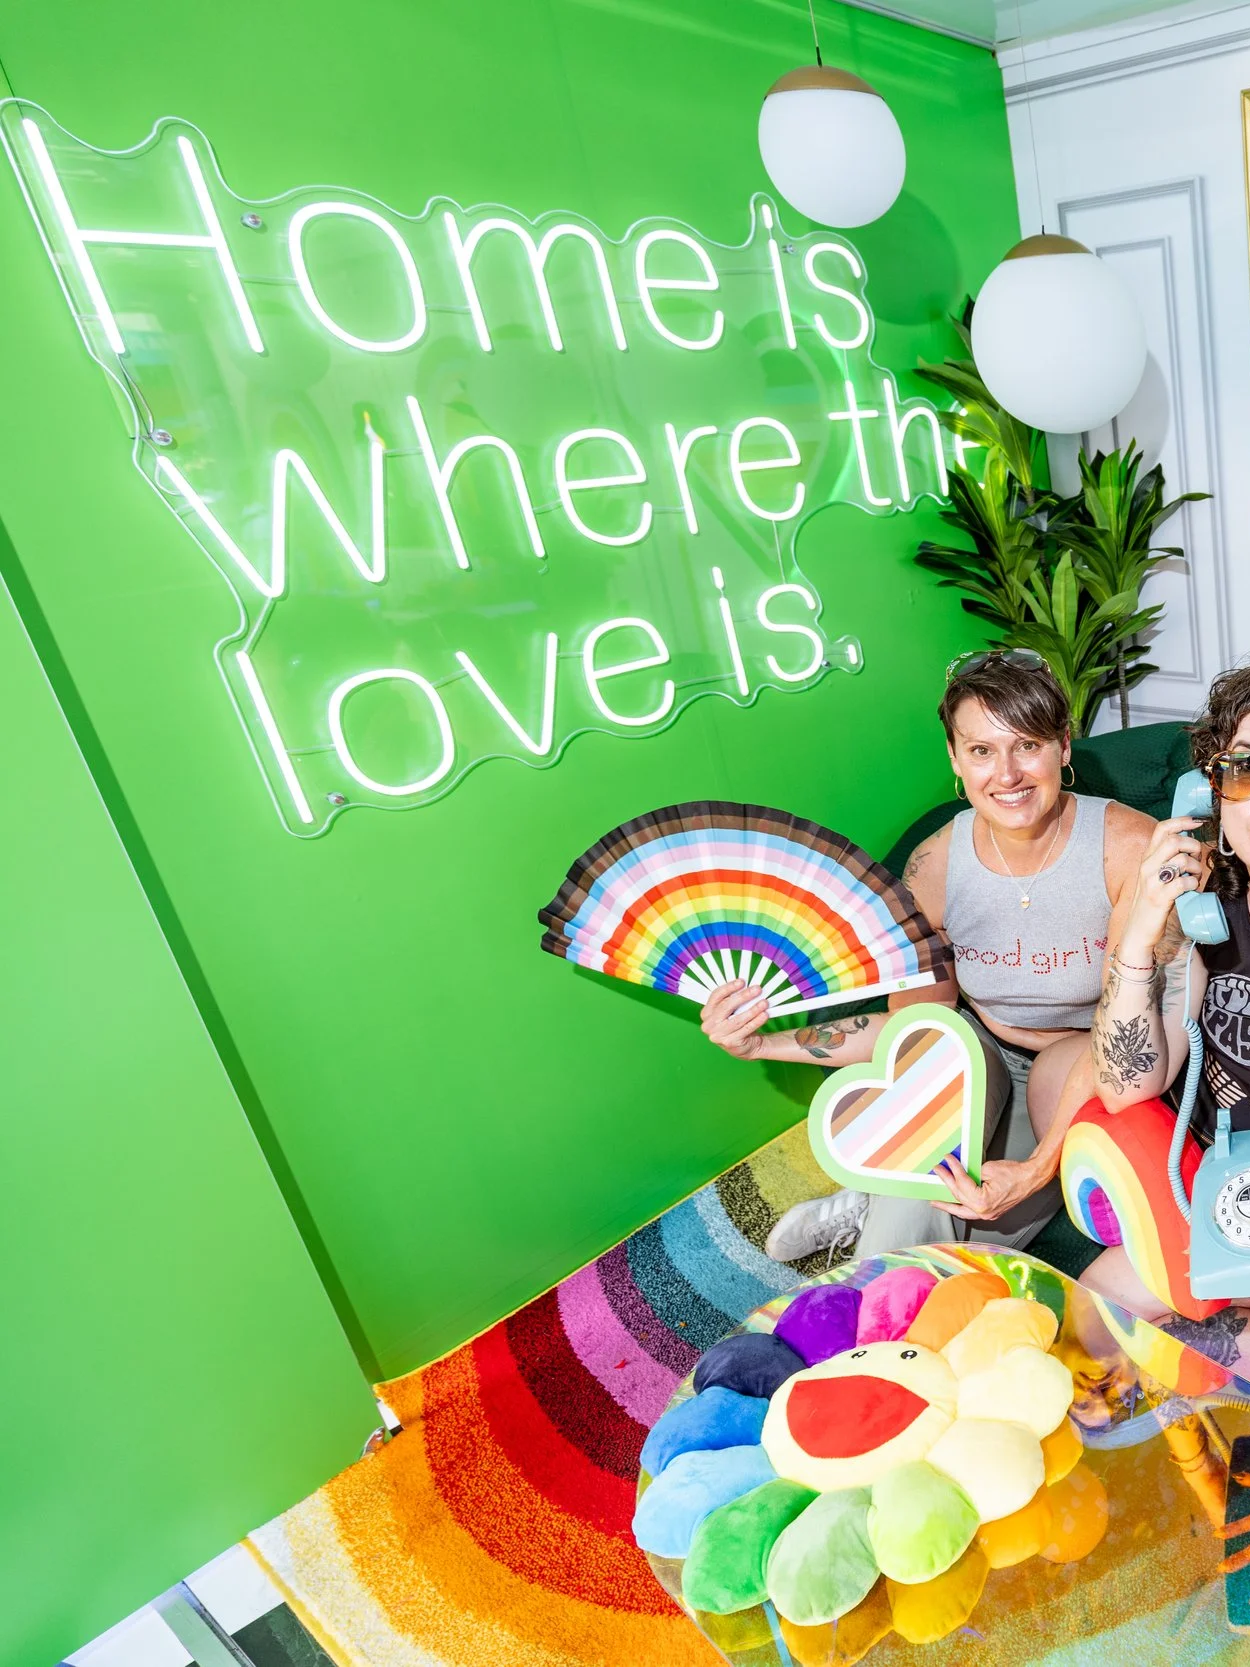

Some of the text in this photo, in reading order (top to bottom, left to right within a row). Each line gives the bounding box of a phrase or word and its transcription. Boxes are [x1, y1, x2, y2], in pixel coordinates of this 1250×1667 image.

[20, 117, 870, 355] Home is
[155, 395, 806, 599] where
[235, 565, 859, 825] love is.
[1031, 936, 1091, 974] girl
[1222, 1195, 1227, 1203] 7
[1221, 1207, 1227, 1215] 8
[1226, 1218, 1232, 1226] 9
[1236, 1226, 1242, 1234] 0
